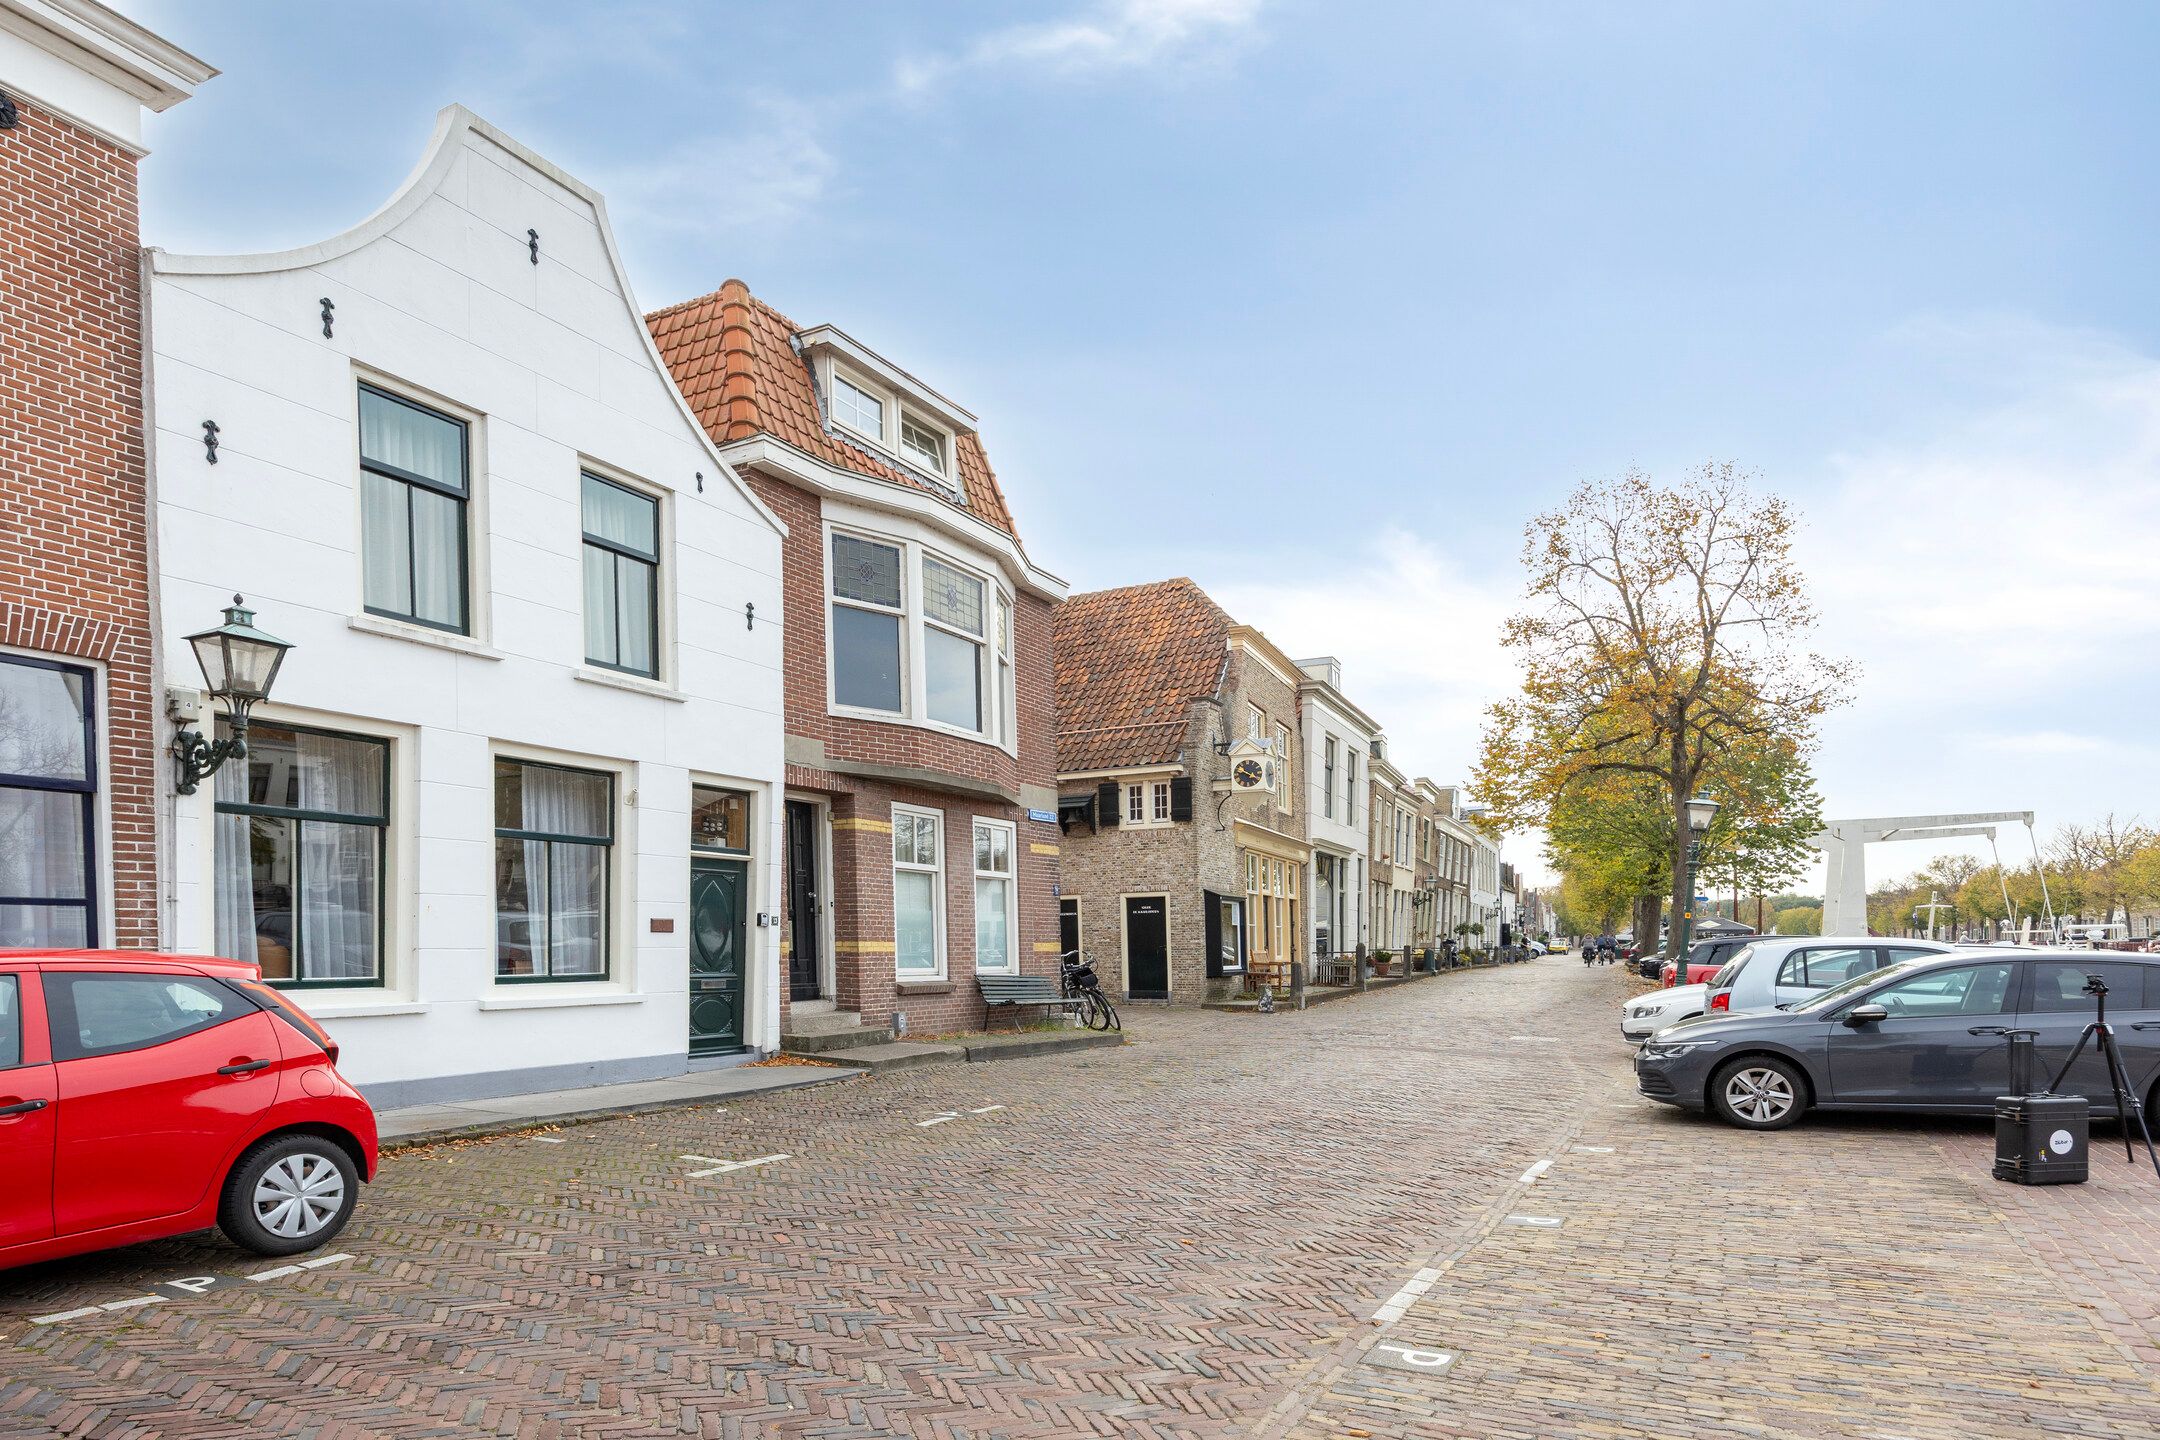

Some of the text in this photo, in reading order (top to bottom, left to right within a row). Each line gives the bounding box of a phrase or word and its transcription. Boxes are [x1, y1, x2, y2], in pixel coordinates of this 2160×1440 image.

[1508, 1216, 1561, 1224] P
[165, 1276, 216, 1294] P
[1378, 1344, 1452, 1367] P
